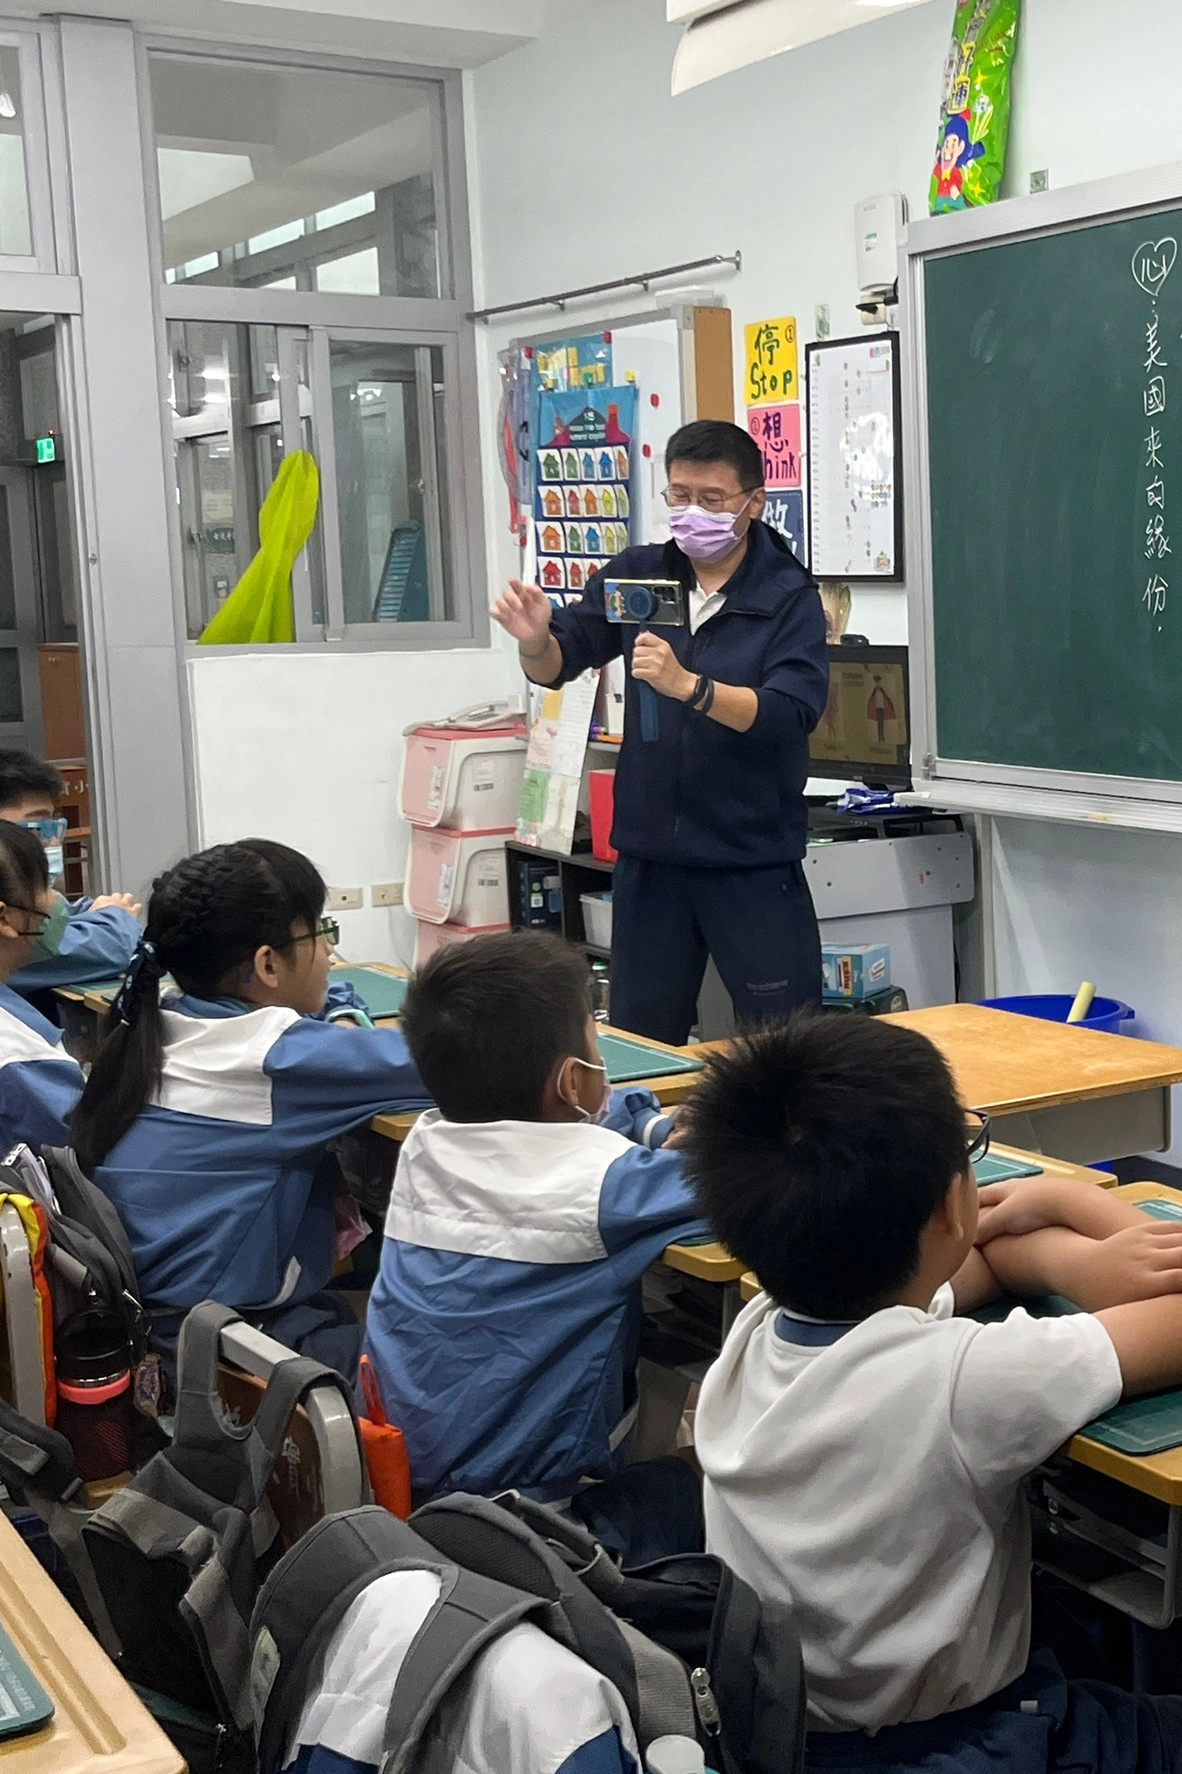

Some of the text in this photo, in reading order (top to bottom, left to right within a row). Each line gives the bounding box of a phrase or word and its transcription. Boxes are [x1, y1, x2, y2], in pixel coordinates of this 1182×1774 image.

[754, 324, 780, 365] 停
[750, 362, 793, 399] Stop
[762, 412, 789, 453] 想
[764, 452, 797, 480] hink
